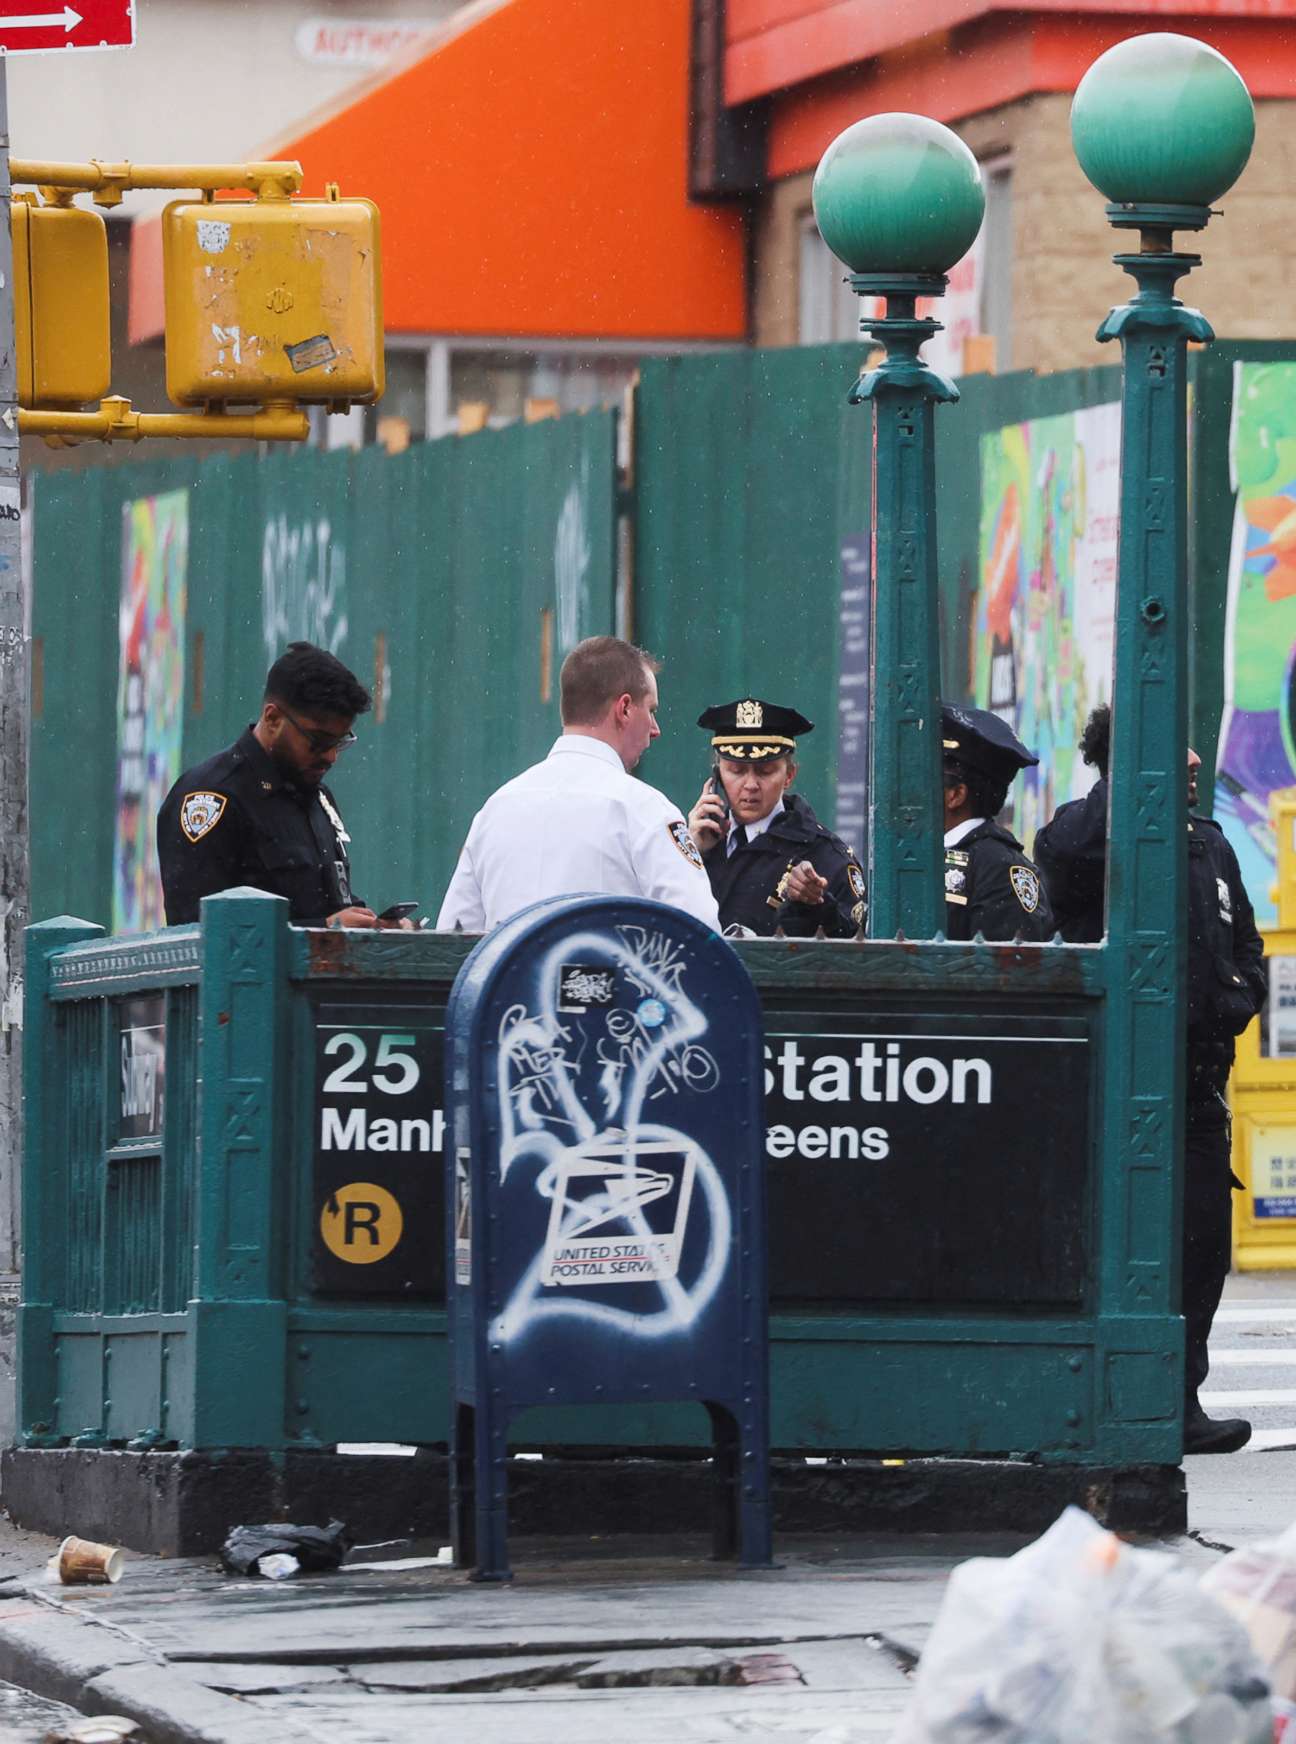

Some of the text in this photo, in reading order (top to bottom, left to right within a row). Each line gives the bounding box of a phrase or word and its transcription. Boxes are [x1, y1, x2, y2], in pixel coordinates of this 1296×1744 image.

[322, 1032, 421, 1095] 25
[764, 1041, 993, 1105] tation
[344, 1201, 382, 1245] R
[554, 1246, 610, 1261] UNITED
[551, 1262, 606, 1277] POSTAL
